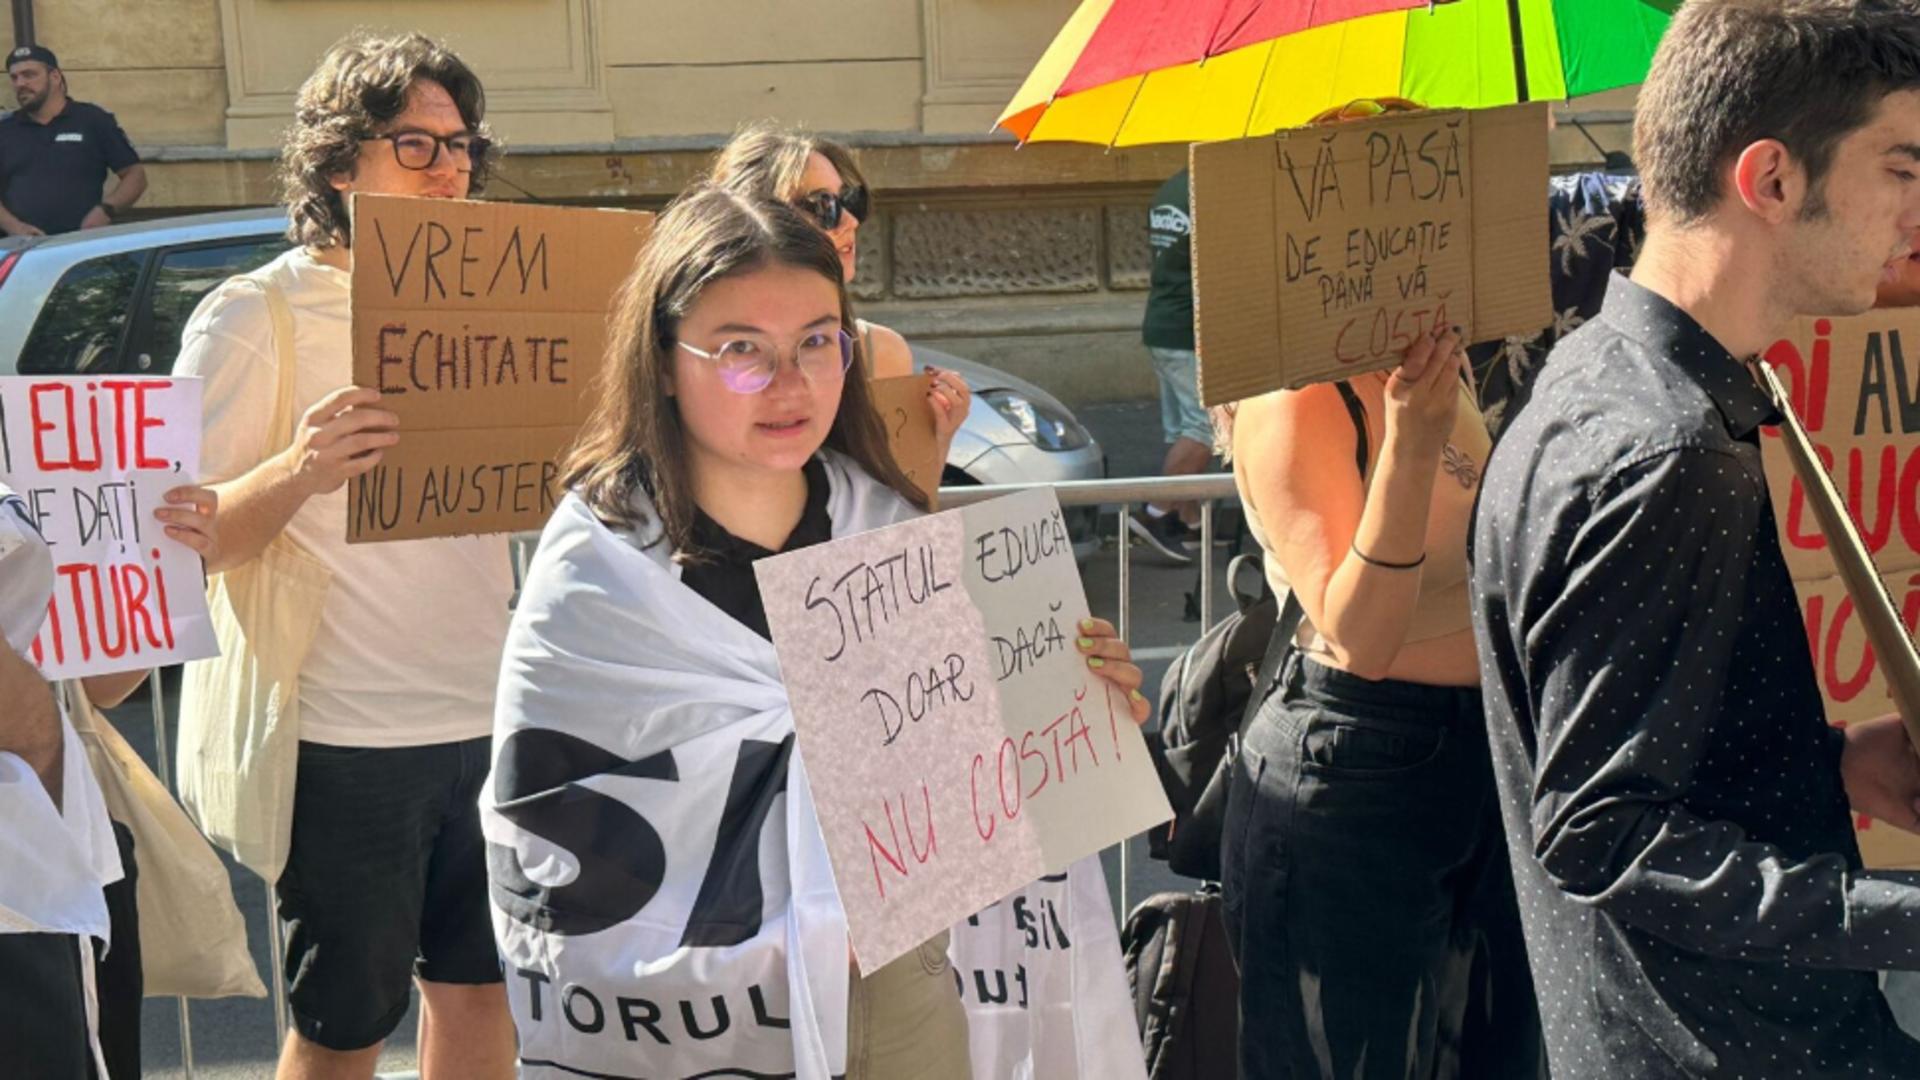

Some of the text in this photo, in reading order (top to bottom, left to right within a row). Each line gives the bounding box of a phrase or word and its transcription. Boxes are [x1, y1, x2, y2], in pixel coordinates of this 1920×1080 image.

[1277, 119, 1464, 221] VĂ PASĂ
[374, 218, 548, 302] VREM
[1286, 221, 1453, 283] DE EDUCAȚIE
[1335, 290, 1453, 364] COSTĂ
[355, 460, 402, 537] NU
[804, 510, 1067, 662] STATUL EDUCĂ
[860, 600, 1065, 746] DOAR DACĂ
[863, 780, 938, 900] NU
[517, 967, 793, 1046] TORUL
